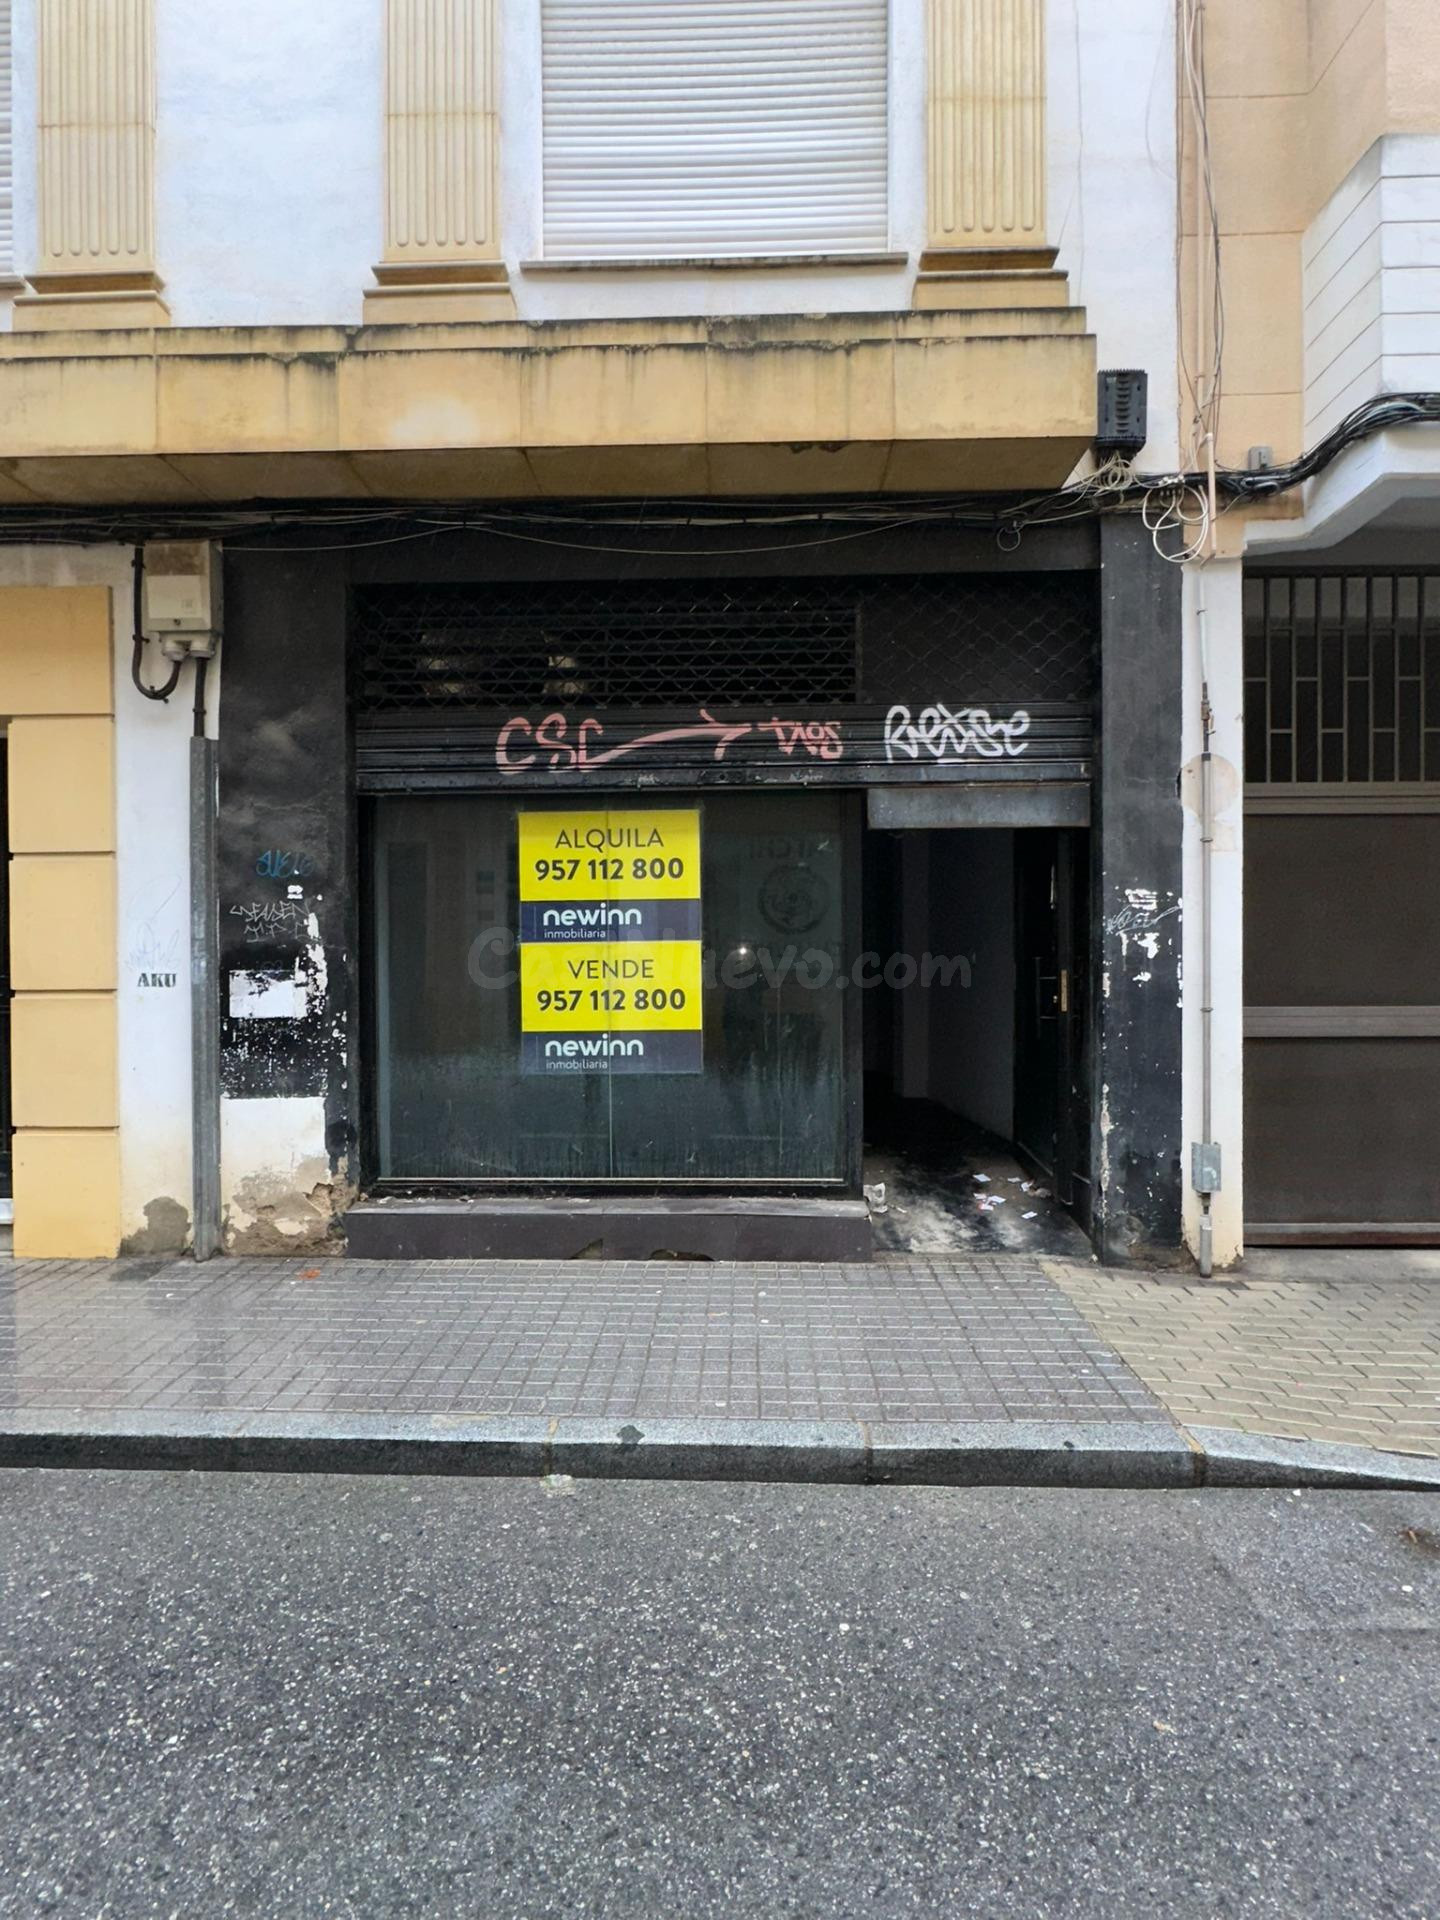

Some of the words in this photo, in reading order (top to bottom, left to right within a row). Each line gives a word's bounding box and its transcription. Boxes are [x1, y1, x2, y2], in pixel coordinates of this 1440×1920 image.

[555, 828, 664, 853] ALQUILA
[535, 858, 580, 881] 957
[588, 858, 623, 880] 112
[632, 857, 684, 880] 800
[543, 902, 642, 926] newinn
[544, 928, 606, 939] inmobiliaria
[137, 972, 177, 988] AKU
[567, 959, 654, 979] VENDE
[537, 989, 583, 1012] 957
[590, 989, 625, 1011] 112
[634, 988, 686, 1011] 800
[545, 1033, 643, 1057] newinn
[546, 1060, 608, 1070] inmobiliaria
